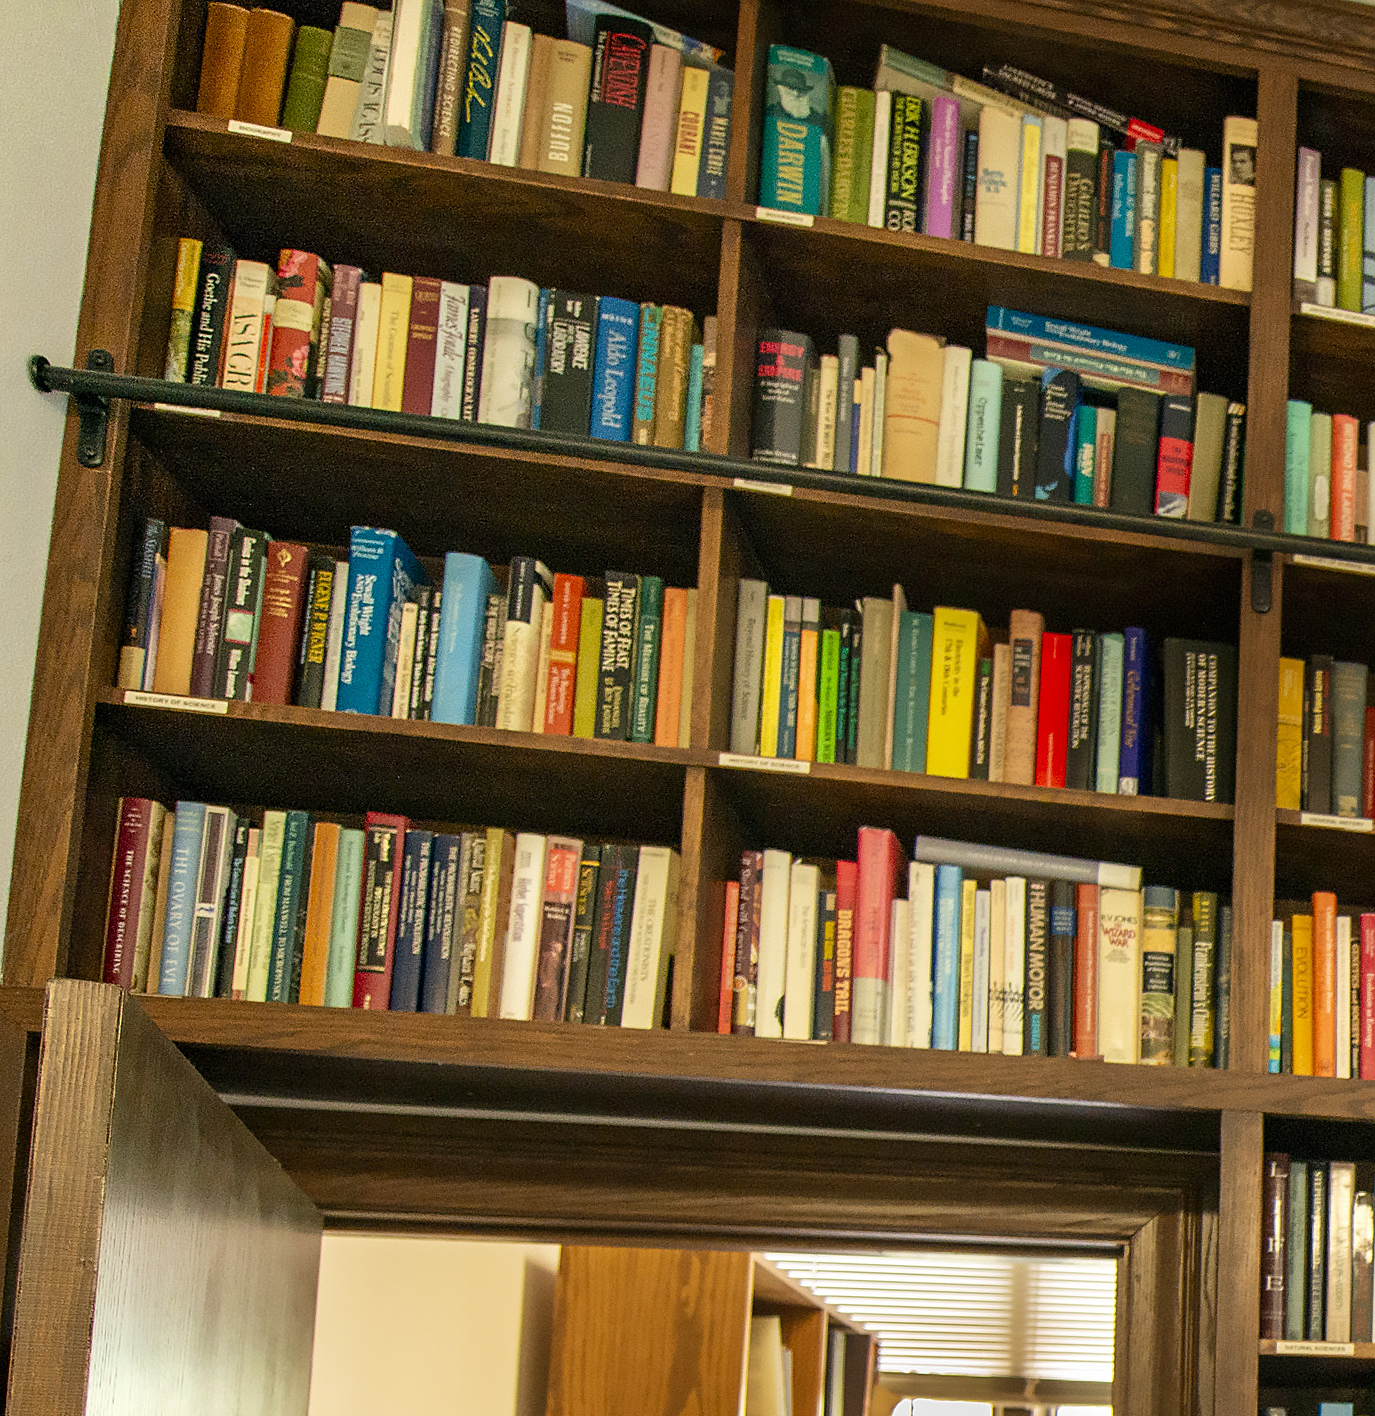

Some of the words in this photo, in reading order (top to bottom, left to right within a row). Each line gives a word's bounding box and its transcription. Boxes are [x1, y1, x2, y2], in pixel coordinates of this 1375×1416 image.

[605, 33, 646, 110] CAVENDISH
[549, 102, 574, 161] BUFFON
[679, 111, 702, 155] COURANT
[777, 120, 808, 204] DARWIN
[1229, 192, 1254, 254] HUXLEY
[202, 273, 220, 308] Goethe
[199, 311, 210, 331] and
[198, 333, 212, 351] His
[606, 330, 626, 364] Aldo
[599, 369, 623, 427] Leopold
[973, 397, 989, 466] Oppenheimer
[606, 582, 621, 613] TIMES
[621, 588, 636, 619] TIMES
[606, 616, 618, 627] OF
[621, 623, 633, 634] OF
[601, 631, 616, 671] FAMINE
[616, 637, 633, 668] FEAST
[1196, 669, 1207, 712] MODERN
[1205, 654, 1218, 716] COMPANION
[1195, 715, 1205, 760] SCIENCE
[1205, 719, 1216, 731] TO
[1205, 734, 1216, 753] THE
[1204, 756, 1215, 801] HISTORY
[126, 850, 134, 867] THE
[175, 847, 190, 875] THE
[122, 870, 132, 904] SCIENCE
[166, 882, 188, 929] OVARY
[1030, 891, 1045, 949] HUMAN
[113, 922, 126, 973] DESCRIBING
[162, 958, 179, 986] EVE
[1028, 952, 1043, 1010] MOTOR
